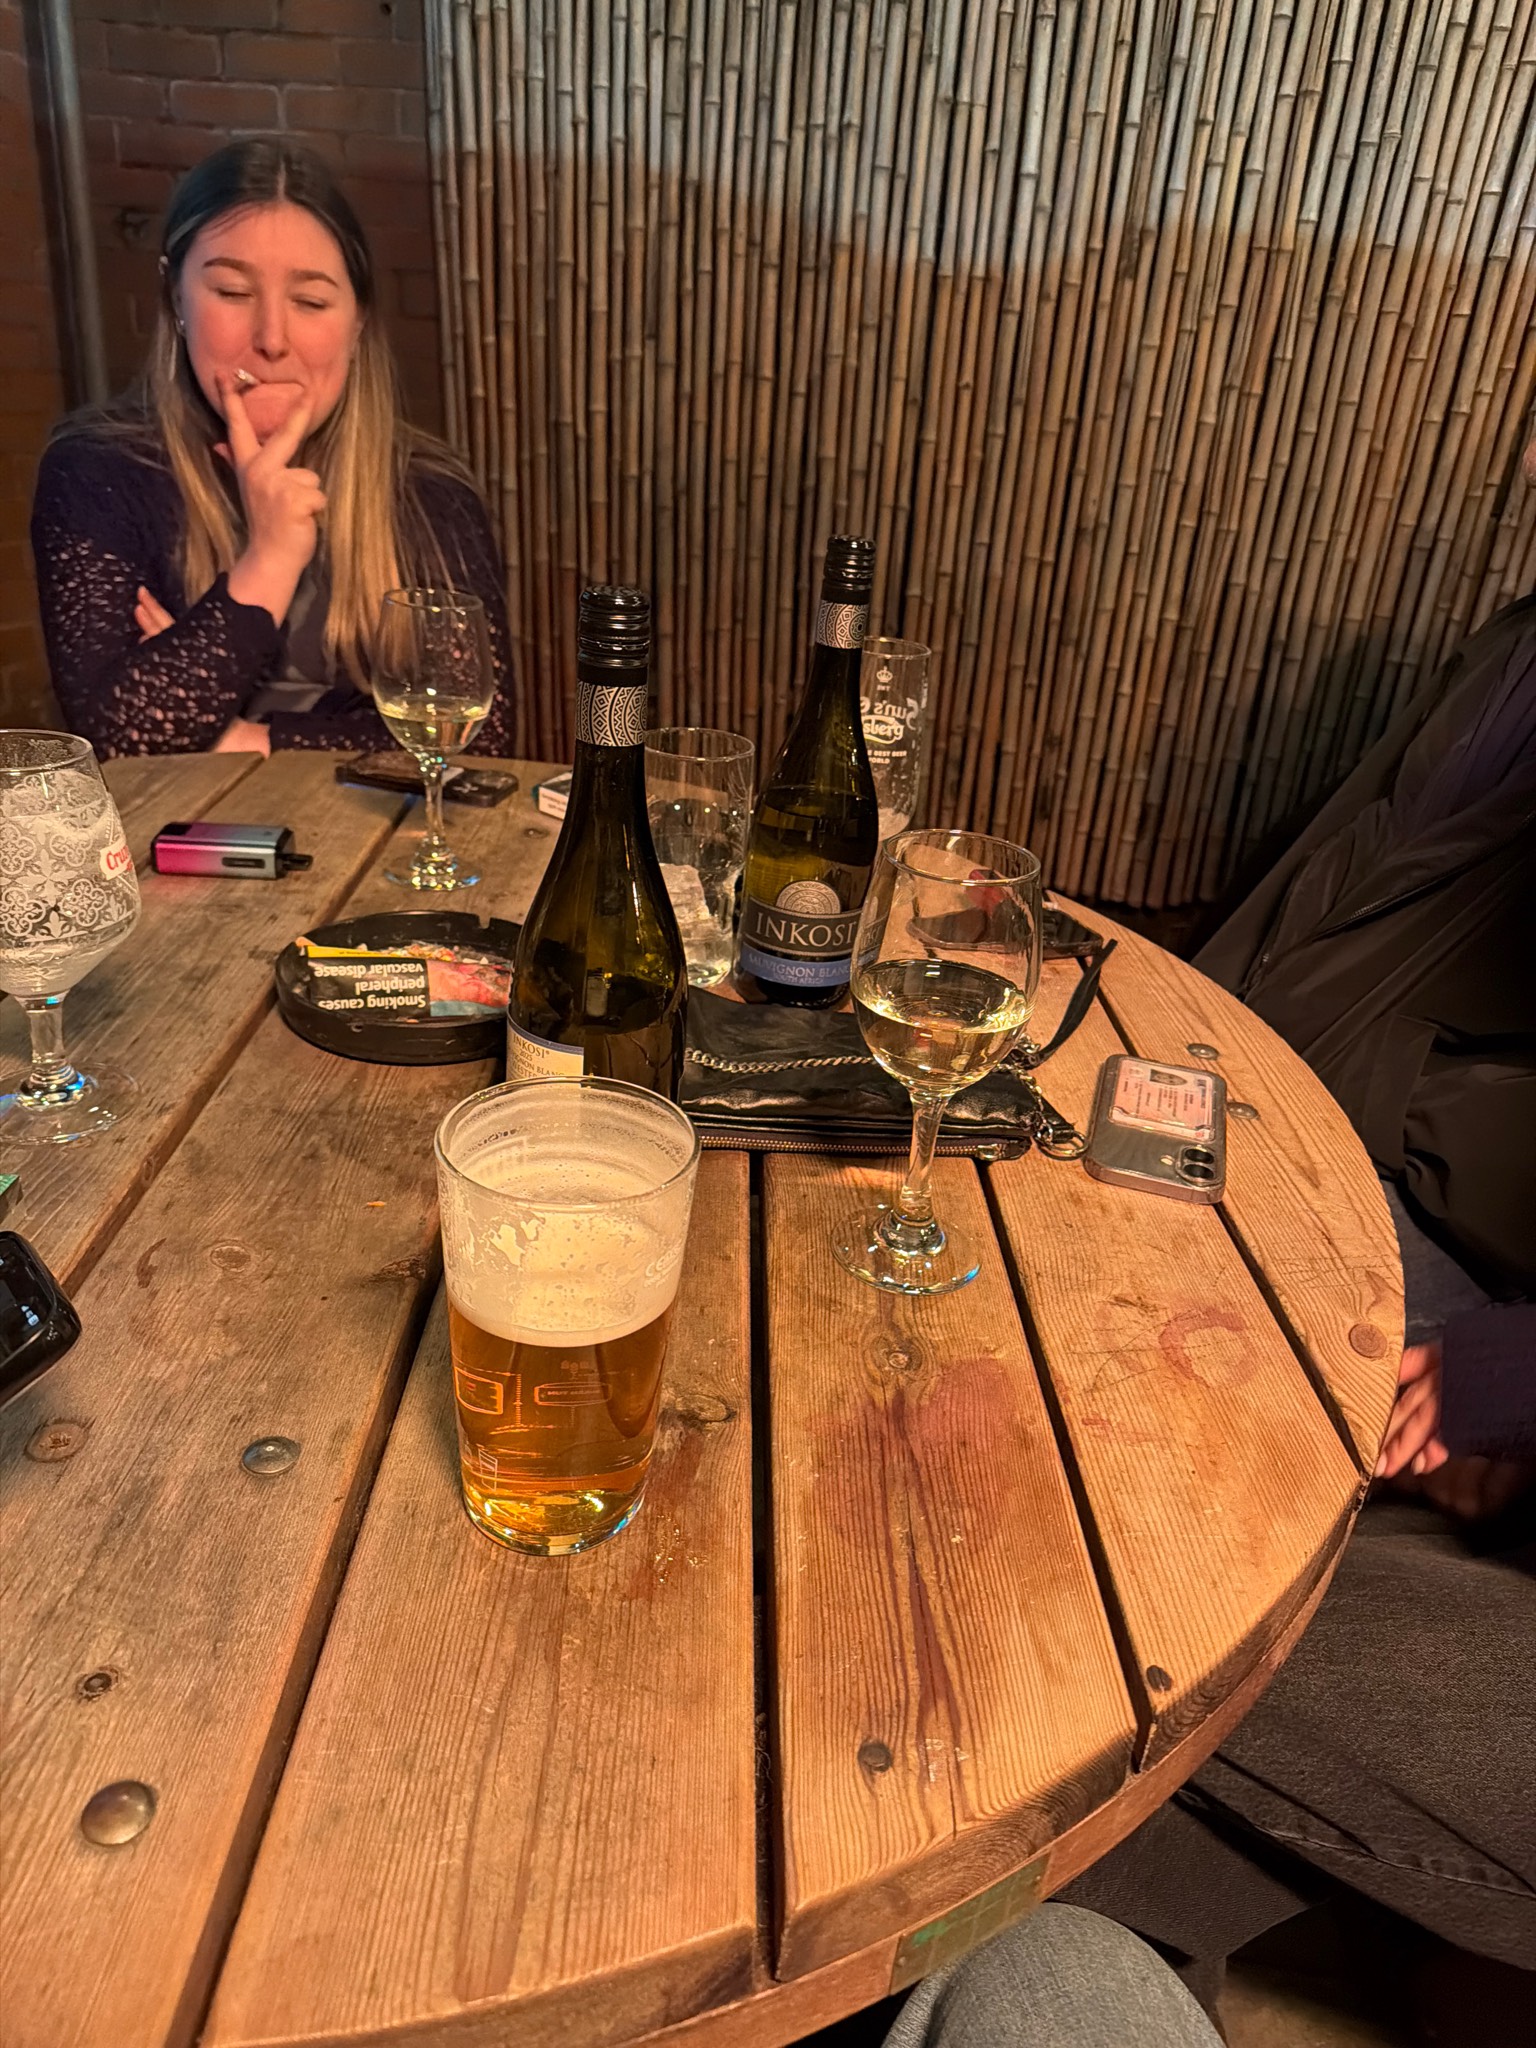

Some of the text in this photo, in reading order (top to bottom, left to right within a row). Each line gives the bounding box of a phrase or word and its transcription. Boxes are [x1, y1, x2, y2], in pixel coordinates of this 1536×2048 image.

[862, 718, 904, 741] sberg
[755, 912, 857, 947] INKOSI
[314, 963, 424, 979] vascular disease
[749, 953, 815, 977] SAUVIGNON
[354, 975, 426, 996] peripheral
[318, 994, 426, 1011] Smoking causes
